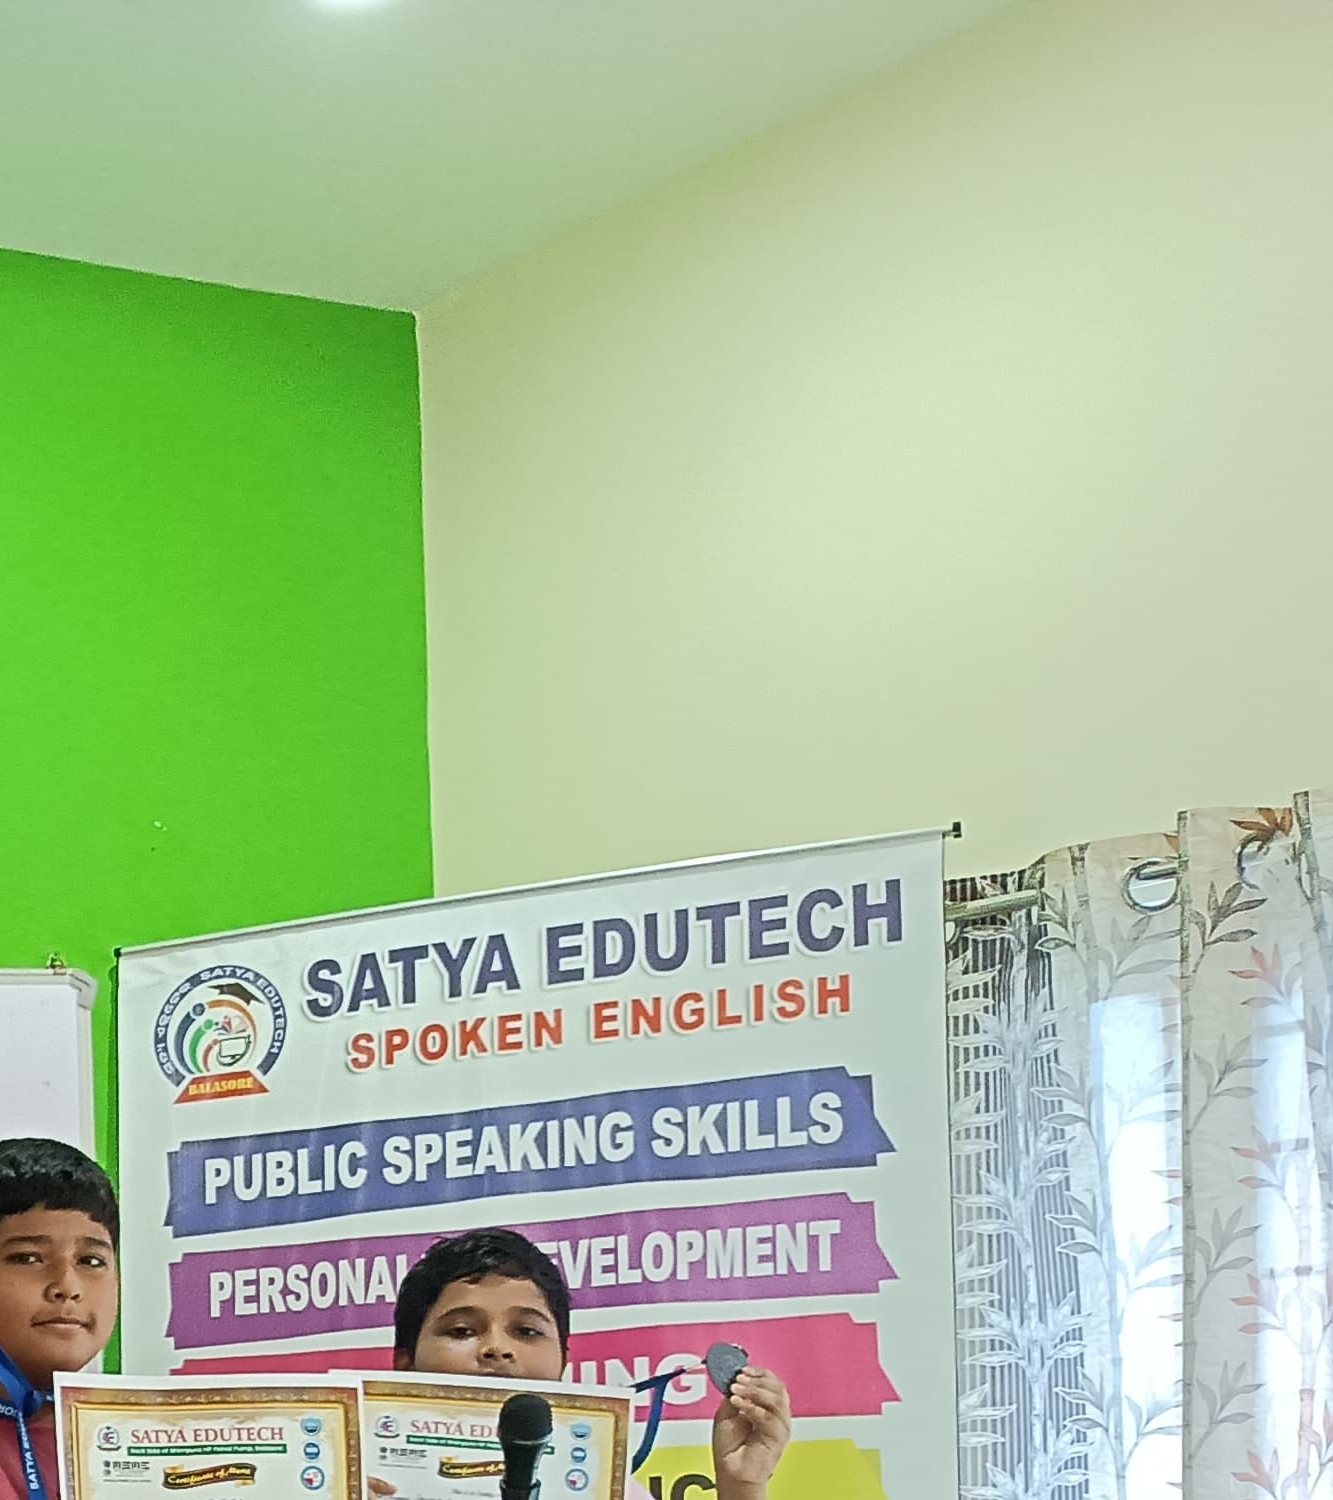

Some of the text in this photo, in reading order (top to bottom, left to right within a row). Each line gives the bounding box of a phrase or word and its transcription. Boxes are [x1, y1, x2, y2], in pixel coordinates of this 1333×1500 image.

[303, 878, 904, 1018] SATYA EDUTECH
[199, 967, 285, 1054] SATYA EDUTECH
[347, 975, 852, 1071] SPOKEN ENGLISH
[188, 1077, 254, 1096] BALASORE
[204, 1092, 845, 1205] PUBLIC SPEAKING SKILLS
[209, 1252, 425, 1318] PERSONAL
[131, 1426, 285, 1444] SATYA EDUTECH
[410, 1419, 464, 1437] SATYA
[24, 1451, 40, 1491] SATYA
